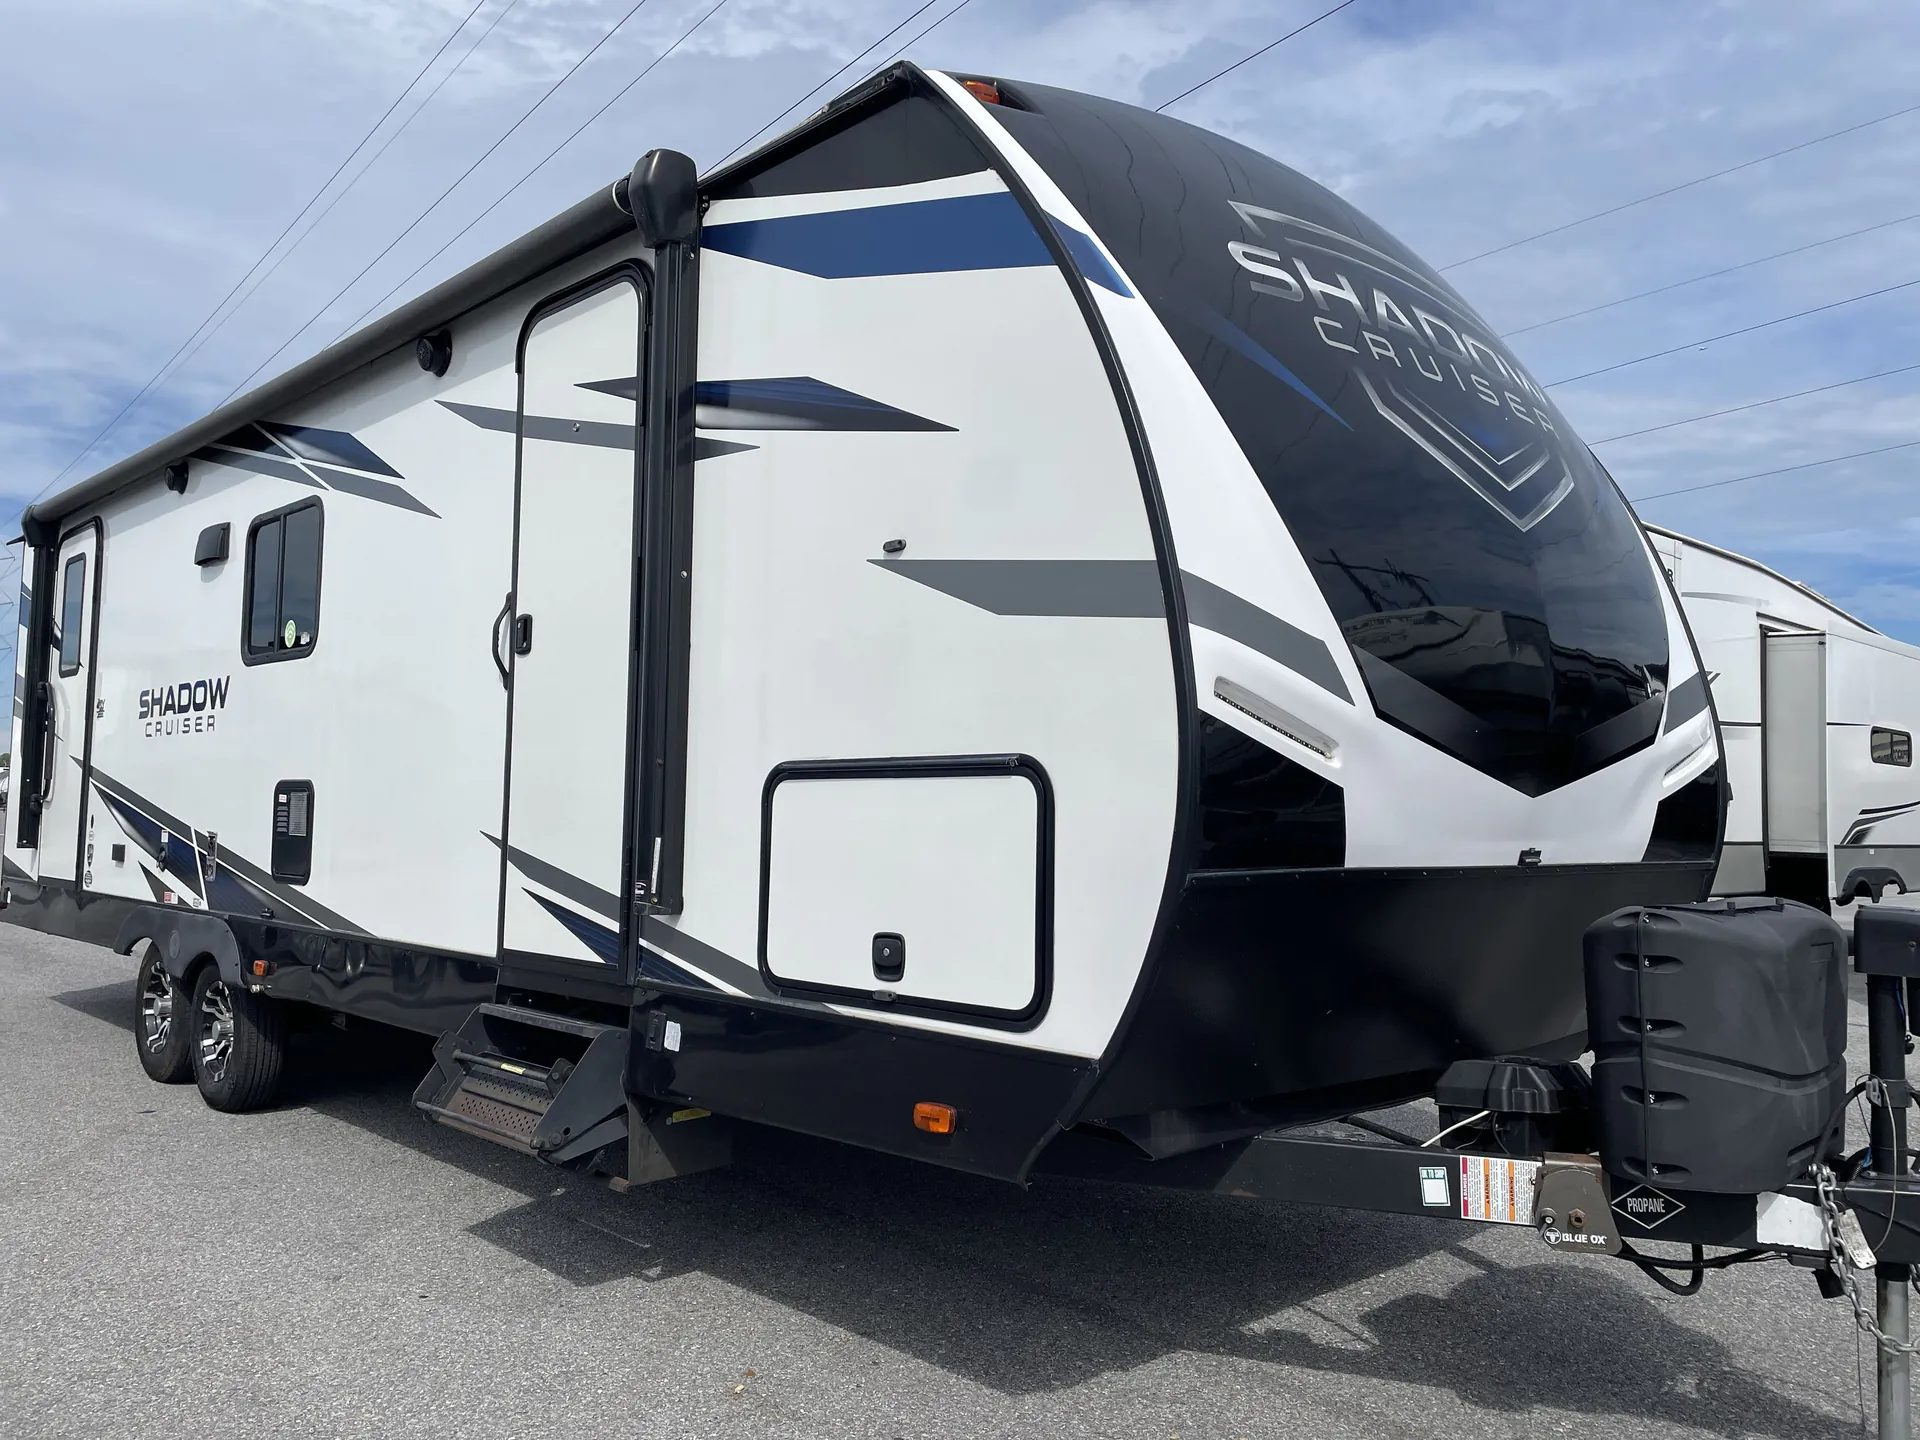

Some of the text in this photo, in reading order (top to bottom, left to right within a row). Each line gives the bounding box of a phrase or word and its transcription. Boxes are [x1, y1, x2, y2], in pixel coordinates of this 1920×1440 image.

[1227, 240, 1549, 408] SHADOW
[1313, 316, 1560, 441] CRUISER
[138, 675, 231, 720] SHADOW
[145, 714, 216, 738] CRUISER
[1627, 1197, 1666, 1213] PROPANE
[1561, 1232, 1588, 1244] BLUE
